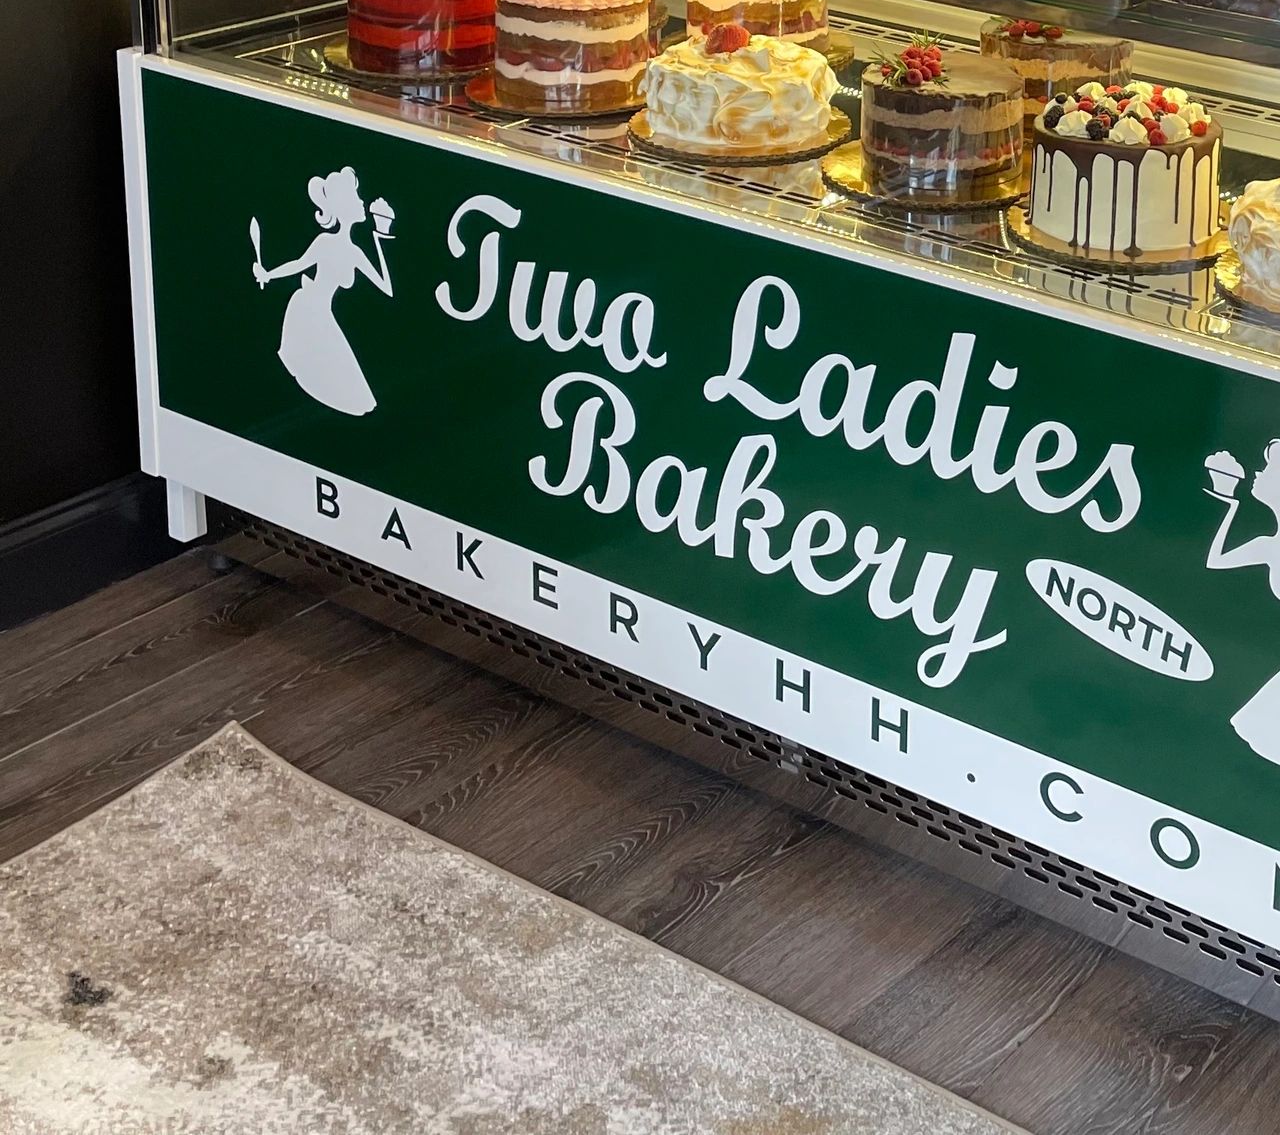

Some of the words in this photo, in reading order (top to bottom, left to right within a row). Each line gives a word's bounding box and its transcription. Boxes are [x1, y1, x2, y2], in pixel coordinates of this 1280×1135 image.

[435, 195, 667, 372] Two
[704, 275, 1141, 533] Ladies
[528, 372, 1007, 688] Bakery
[1045, 566, 1193, 673] NORTH
